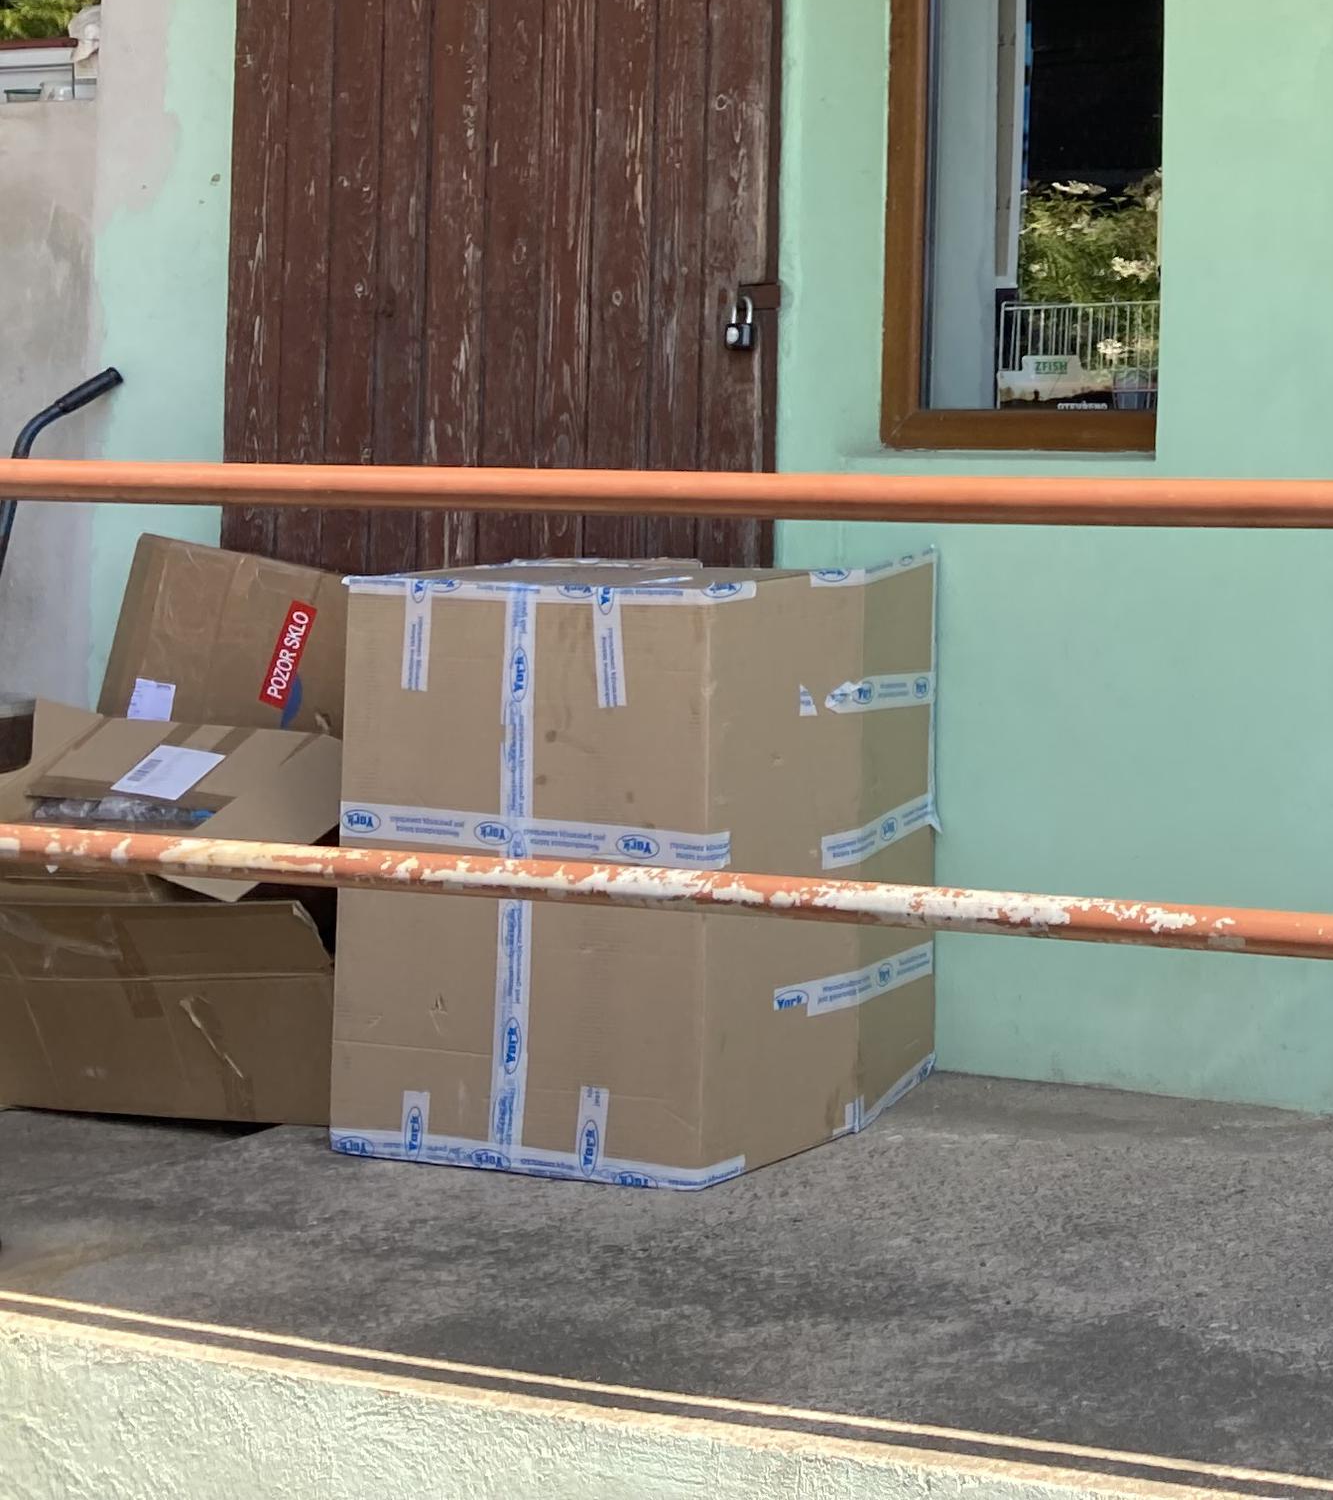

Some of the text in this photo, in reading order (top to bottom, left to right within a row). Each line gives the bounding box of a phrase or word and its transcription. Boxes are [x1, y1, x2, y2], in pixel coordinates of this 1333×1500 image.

[1034, 361, 1068, 372] ZFISH
[266, 610, 309, 699] POZOR SKLO
[512, 655, 525, 693] York
[346, 814, 374, 829] York
[479, 824, 507, 841] York
[622, 837, 652, 855] York
[505, 1026, 519, 1064] York
[408, 1114, 421, 1152] York
[582, 1128, 596, 1166] York
